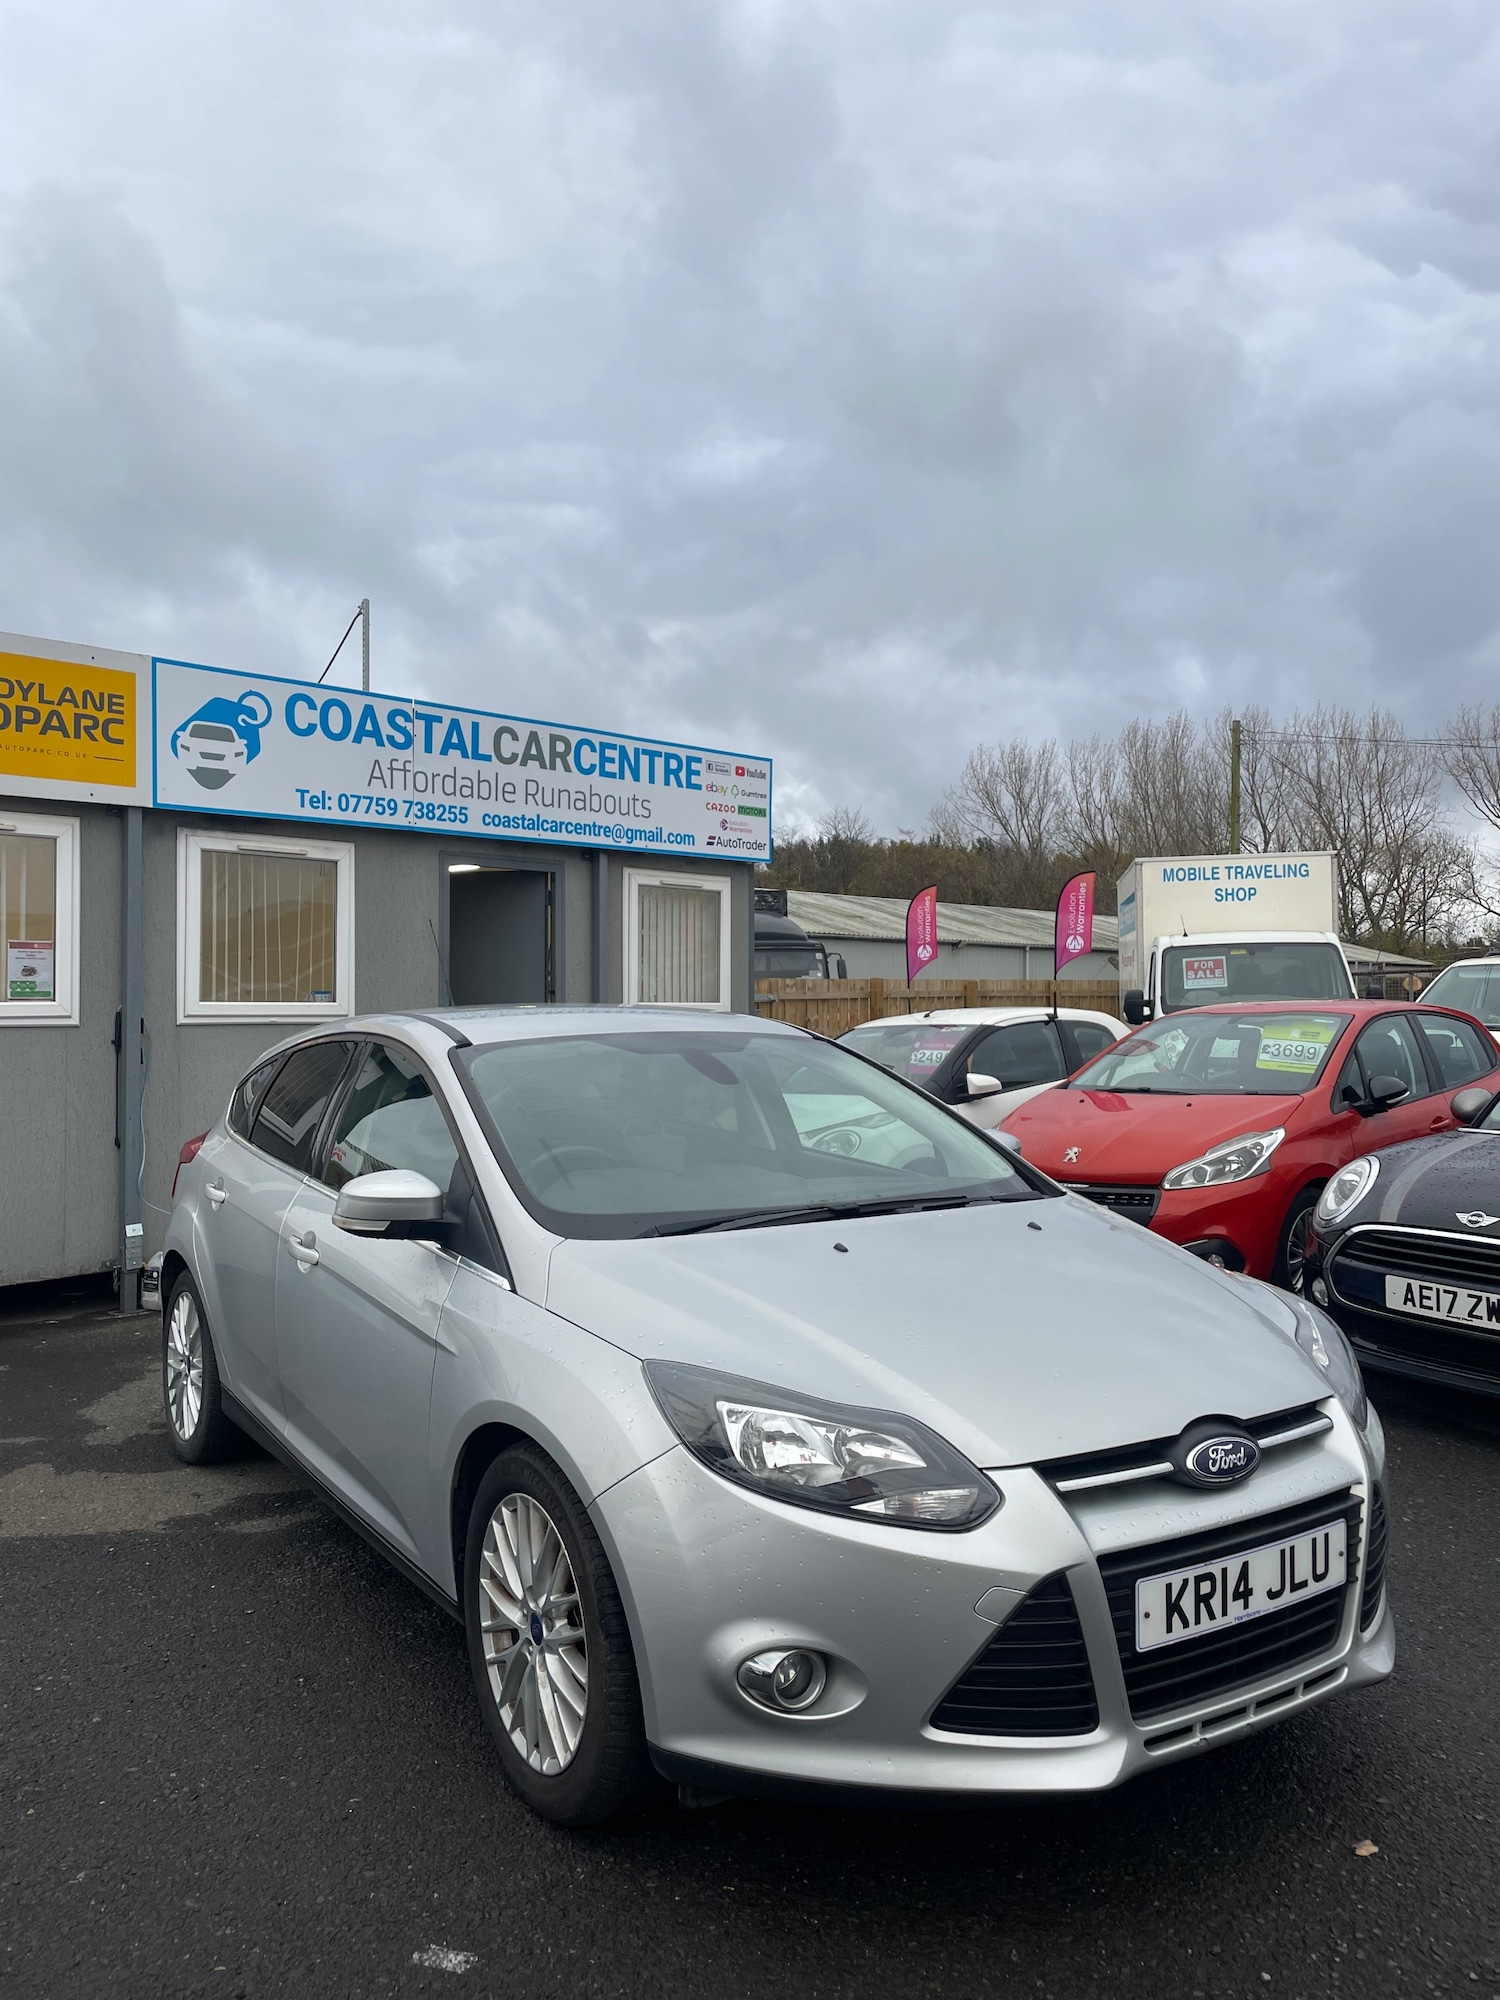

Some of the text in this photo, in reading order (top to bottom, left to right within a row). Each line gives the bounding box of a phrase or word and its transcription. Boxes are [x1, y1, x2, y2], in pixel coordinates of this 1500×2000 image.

[285, 692, 703, 791] COASTALCARCENTRE
[746, 767, 767, 780] YouTube
[367, 758, 652, 818] Affordable Runabouts
[705, 781, 728, 797] ebay
[741, 790, 767, 800] Gumtree
[295, 788, 695, 846] Tel: 07759 738255 coastalcarcentre@gmail.com
[705, 802, 736, 814] CAZOO
[716, 836, 767, 851] AutoTrader
[1162, 863, 1310, 883] MOBILE TRAVELING
[1214, 887, 1257, 902] SHOP
[1067, 892, 1077, 934] Evolution
[1077, 882, 1087, 934] Warranties
[923, 895, 931, 943] Warranties
[1187, 968, 1223, 979] SALE
[1193, 960, 1214, 970] FOR
[910, 1051, 949, 1064] £249
[1261, 1042, 1317, 1061] £3699
[1403, 1282, 1458, 1314] AE17
[1208, 1443, 1248, 1473] Ford
[1165, 1532, 1330, 1635] KR14 JLU
